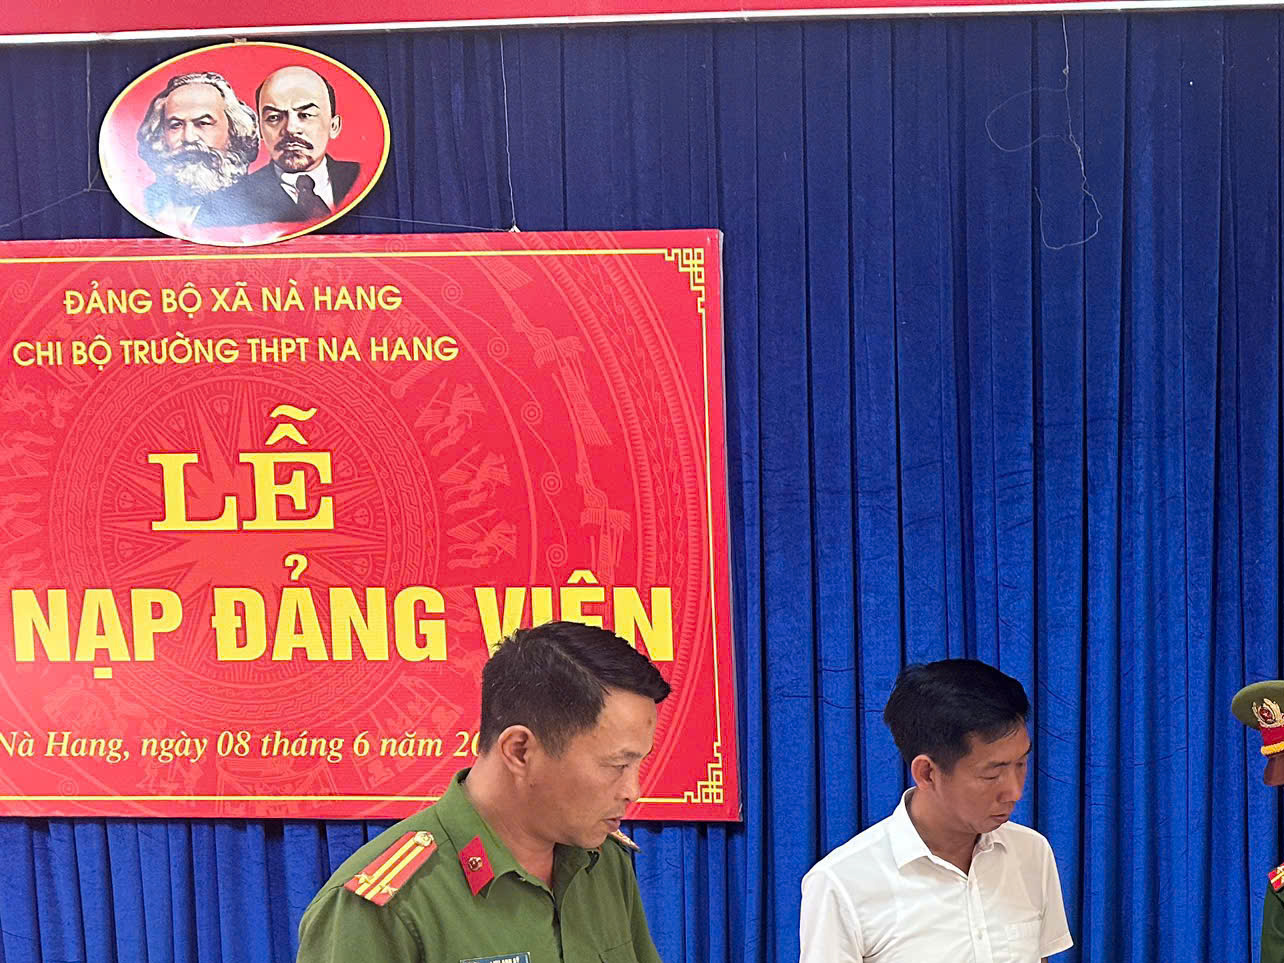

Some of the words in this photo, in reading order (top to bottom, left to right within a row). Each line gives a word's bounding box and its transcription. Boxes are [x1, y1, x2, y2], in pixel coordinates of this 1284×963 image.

[63, 280, 152, 315] ĐẢNG
[161, 282, 203, 319] BỘ
[211, 283, 253, 312] XÃ
[261, 280, 305, 312] NÀ
[313, 284, 403, 311] HANG
[12, 340, 63, 366] CHI
[72, 334, 113, 371] BỘ
[120, 331, 240, 365] TRƯỜNG
[247, 337, 309, 363] THPT
[318, 337, 361, 362] NA
[369, 335, 460, 362] HANG
[147, 403, 335, 531] LỄ
[11, 588, 184, 679] NẠP
[211, 555, 447, 662] ĐẢNG
[0, 730, 34, 757] Nà
[45, 731, 130, 763] Hang,
[140, 730, 208, 763] ngày
[216, 730, 251, 757] 08
[261, 730, 345, 763] tháng
[353, 730, 370, 757] 6
[379, 731, 442, 757] năm
[453, 730, 481, 757] 20
